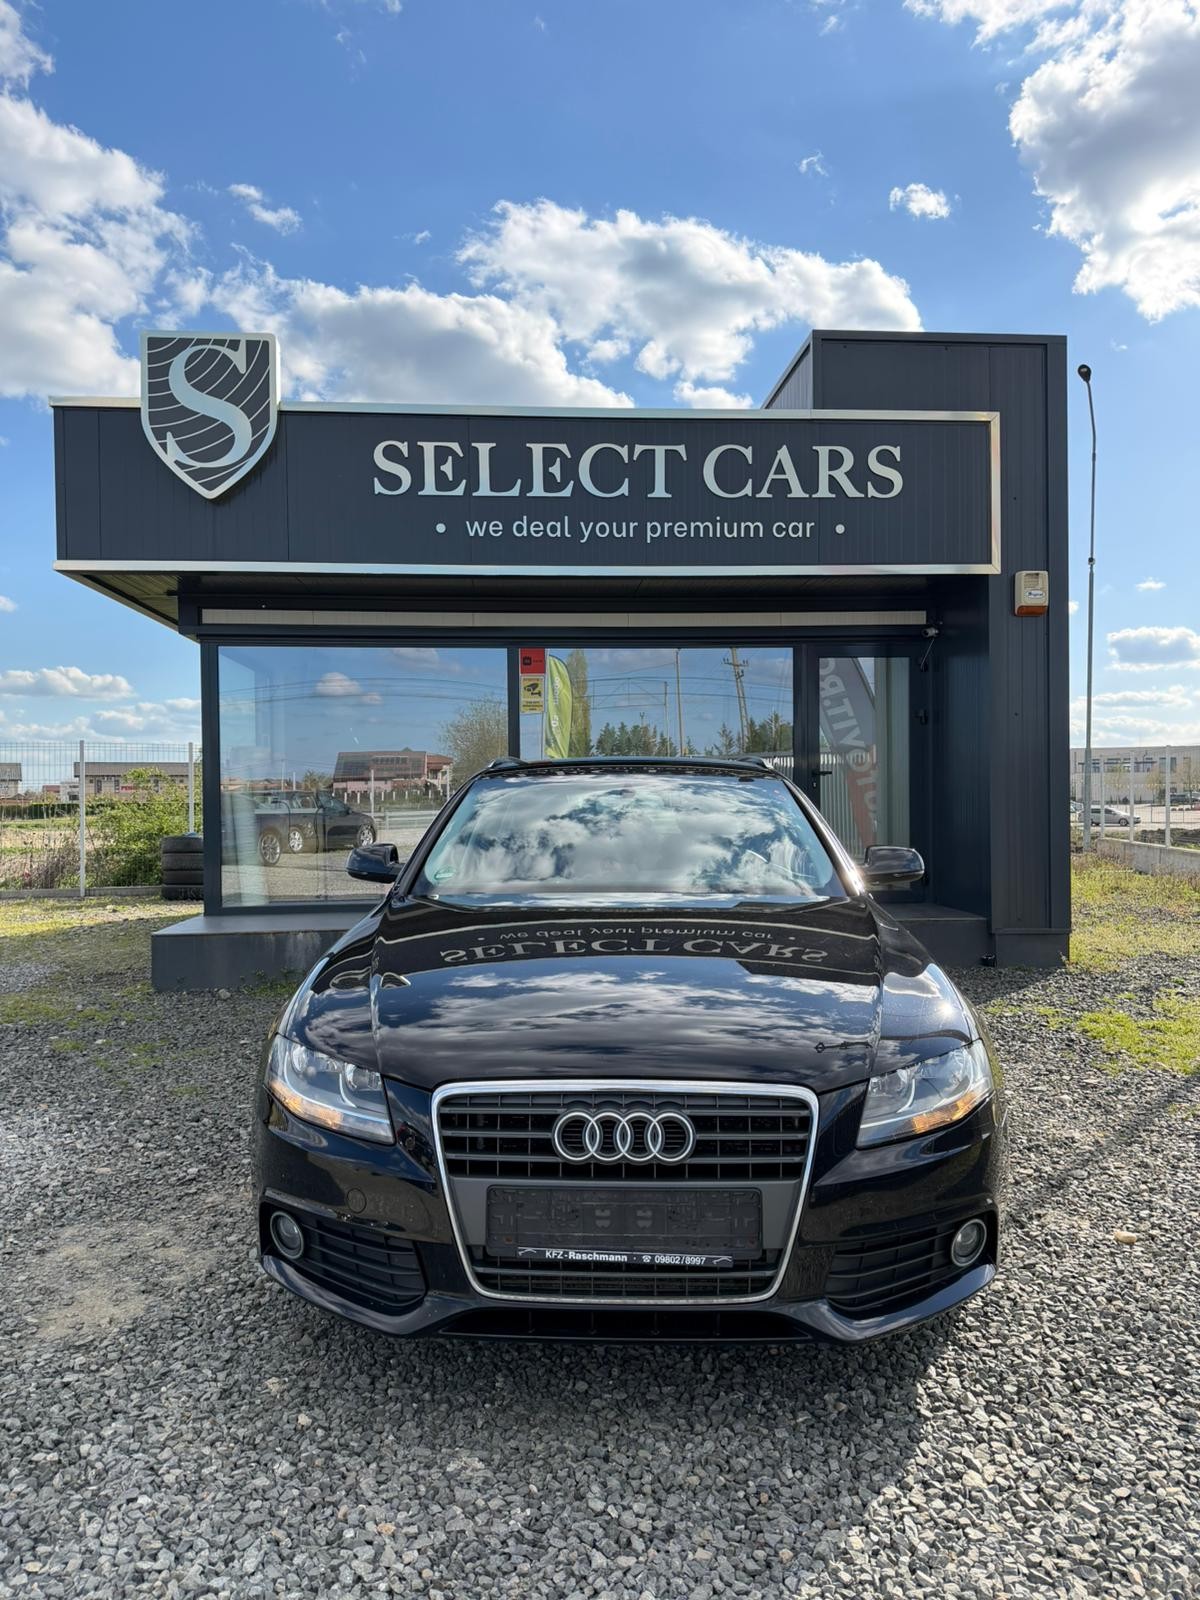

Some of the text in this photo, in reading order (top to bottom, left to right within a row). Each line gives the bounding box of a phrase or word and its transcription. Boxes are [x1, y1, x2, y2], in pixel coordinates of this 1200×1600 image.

[168, 338, 252, 468] S
[372, 439, 905, 500] SELECT CARS
[465, 515, 815, 544] we deal your premium car
[545, 1249, 706, 1265] KFZ-Raschmann 09802/8997
